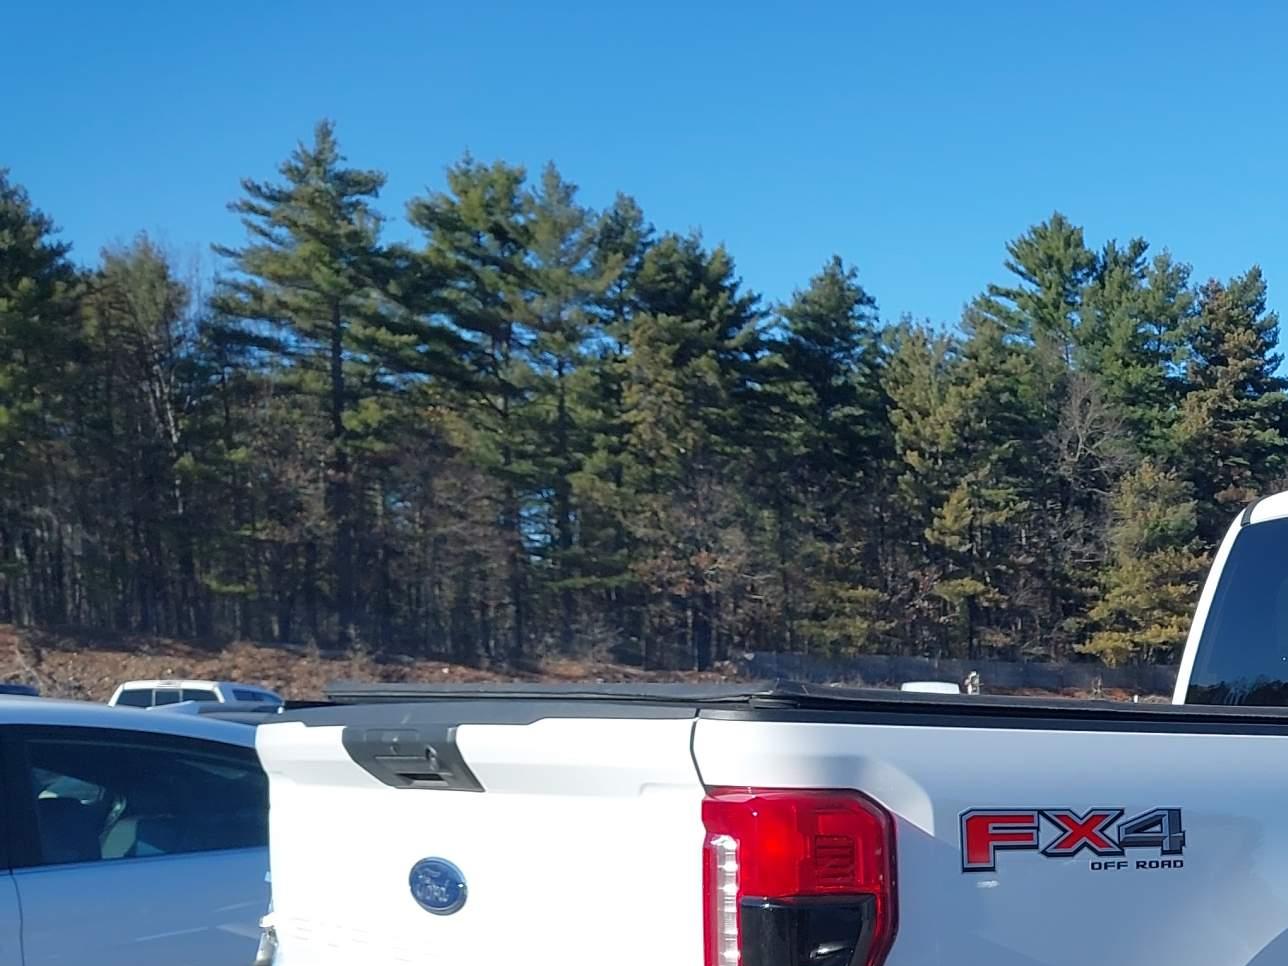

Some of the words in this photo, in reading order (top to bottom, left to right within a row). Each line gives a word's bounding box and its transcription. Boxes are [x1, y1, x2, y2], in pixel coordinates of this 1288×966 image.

[959, 807, 1187, 873] FX4
[1090, 860, 1129, 871] OFF
[1135, 858, 1184, 870] ROAD
